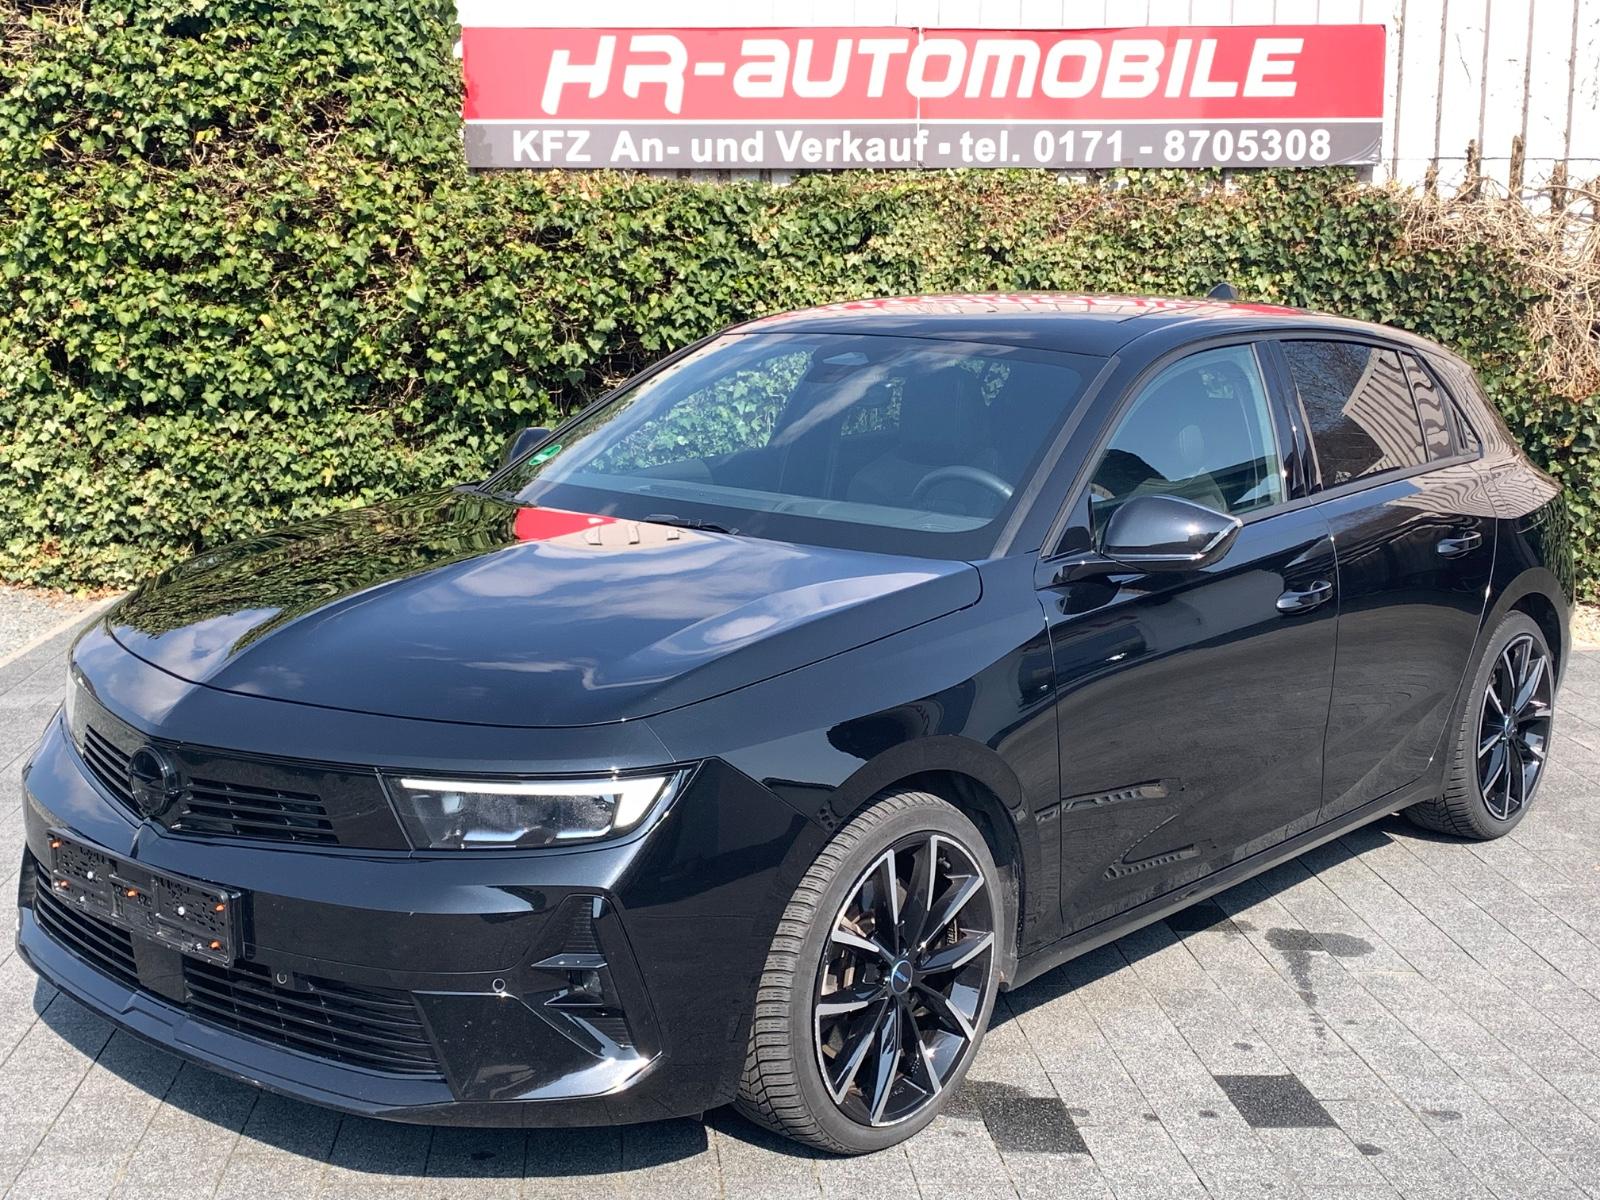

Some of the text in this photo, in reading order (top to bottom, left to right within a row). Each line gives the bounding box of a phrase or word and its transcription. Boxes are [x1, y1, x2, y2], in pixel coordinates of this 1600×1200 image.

[512, 131, 592, 161] KFZ
[610, 131, 680, 162] An-
[691, 131, 764, 162] und
[775, 131, 929, 162] Verkauf
[960, 131, 1020, 162] tel.
[1033, 130, 1123, 162] 0171
[1164, 130, 1331, 162] 8705308
